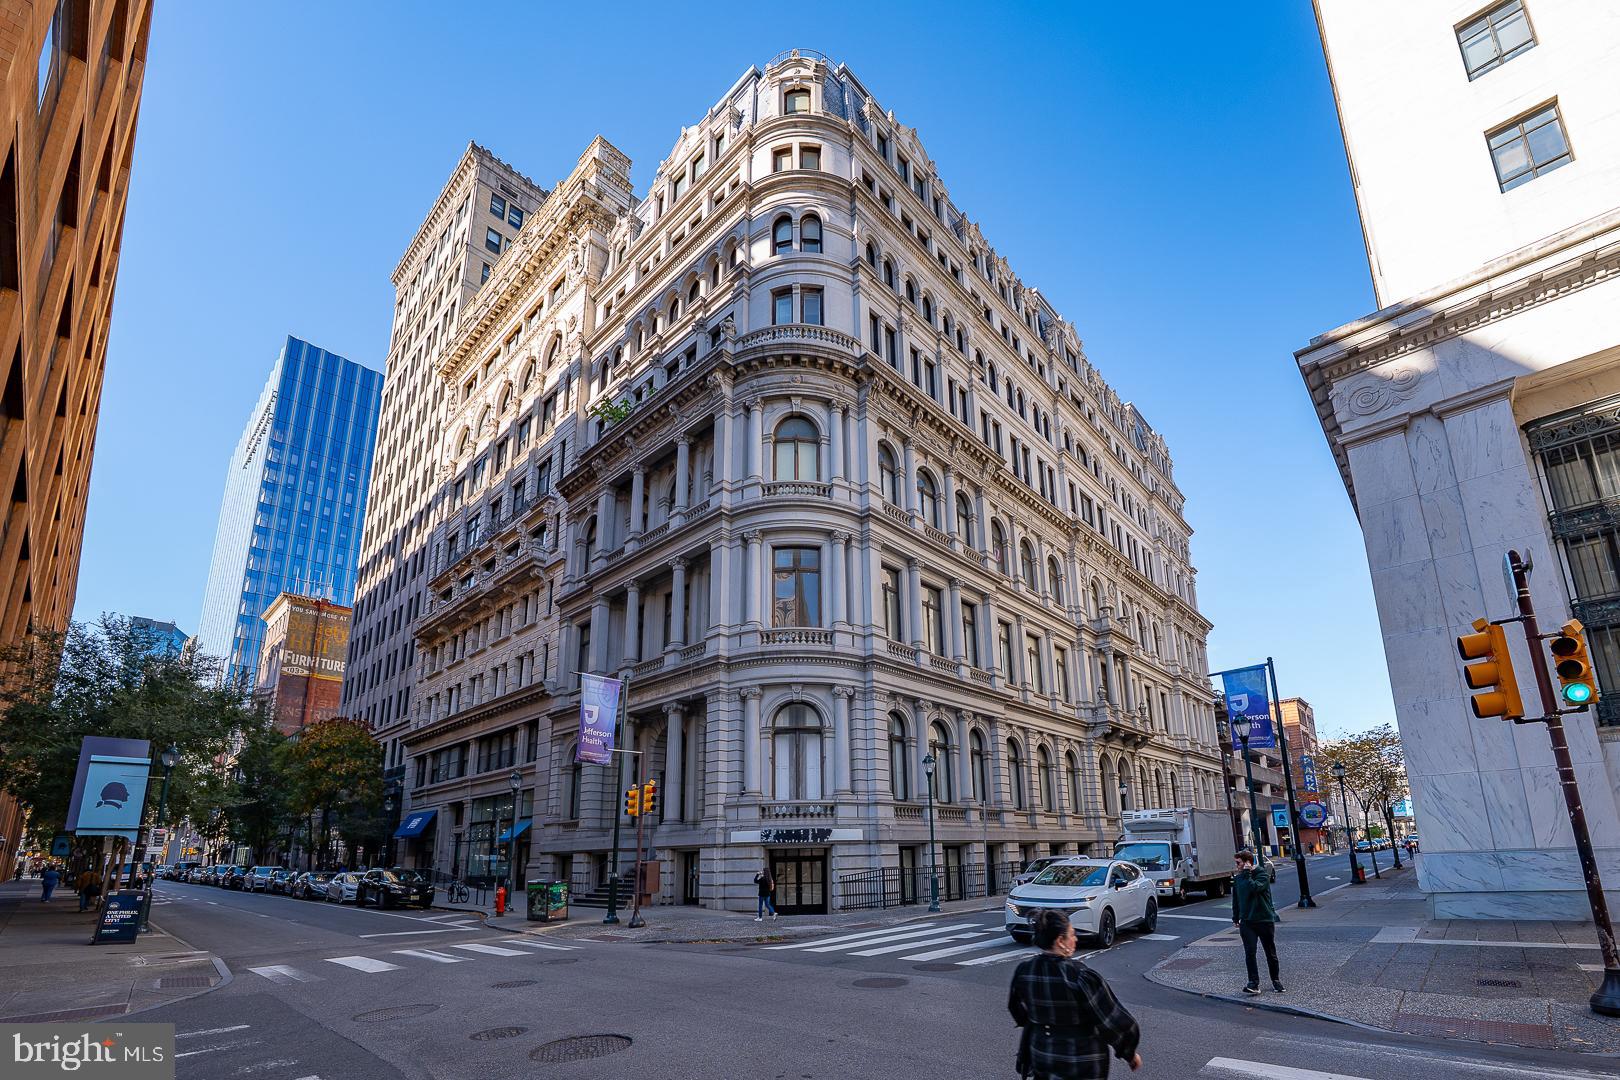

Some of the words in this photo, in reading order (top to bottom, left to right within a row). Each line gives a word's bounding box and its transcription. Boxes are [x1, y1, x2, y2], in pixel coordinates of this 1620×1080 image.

[283, 649, 346, 673] FURNITURE
[583, 726, 612, 738] Jefferson
[582, 735, 603, 746] Health
